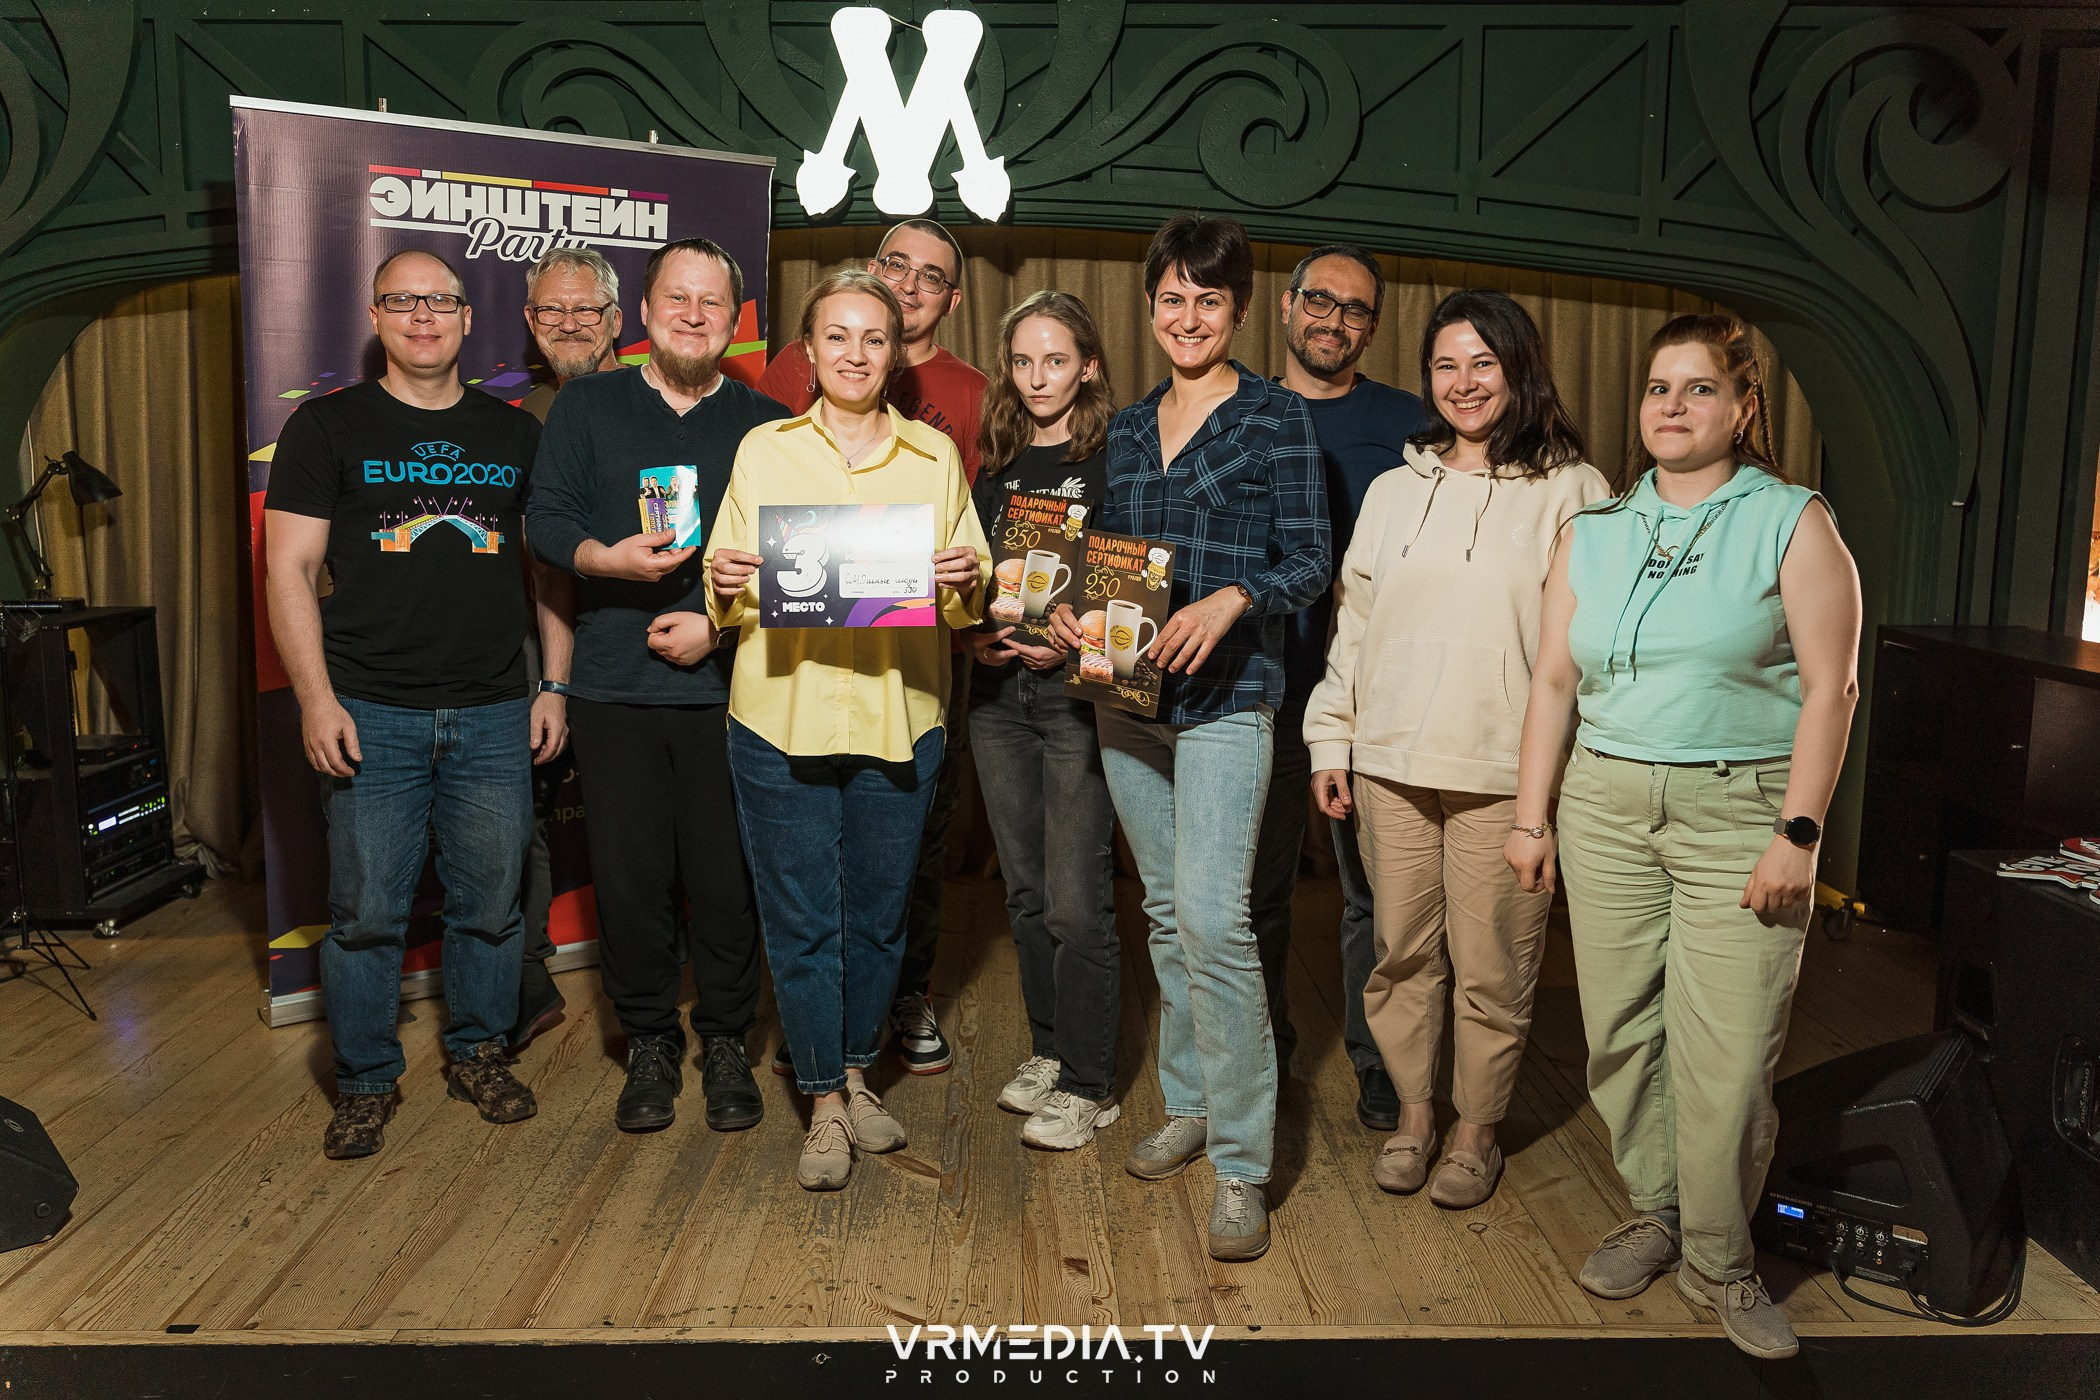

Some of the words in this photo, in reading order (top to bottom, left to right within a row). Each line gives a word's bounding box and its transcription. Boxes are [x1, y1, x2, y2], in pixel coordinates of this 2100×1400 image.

[370, 169, 668, 239] ЭЙНШТЕЙН
[414, 444, 460, 459] UEFA
[1004, 479, 1021, 491] THE
[1010, 494, 1067, 512] ПОДАРОЧНЫЙ
[1007, 507, 1064, 525] СЕРТИФИКАТ
[1003, 527, 1040, 548] 250
[1088, 535, 1147, 556] ПОДАРОЧНЫЙ
[776, 533, 830, 598] 3
[1086, 550, 1145, 572] СЕРТИФИКАТ
[1686, 552, 1705, 564] SAY
[1647, 565, 1698, 579] NOHING
[1084, 573, 1120, 597] 250
[782, 601, 826, 613] МЕСТО
